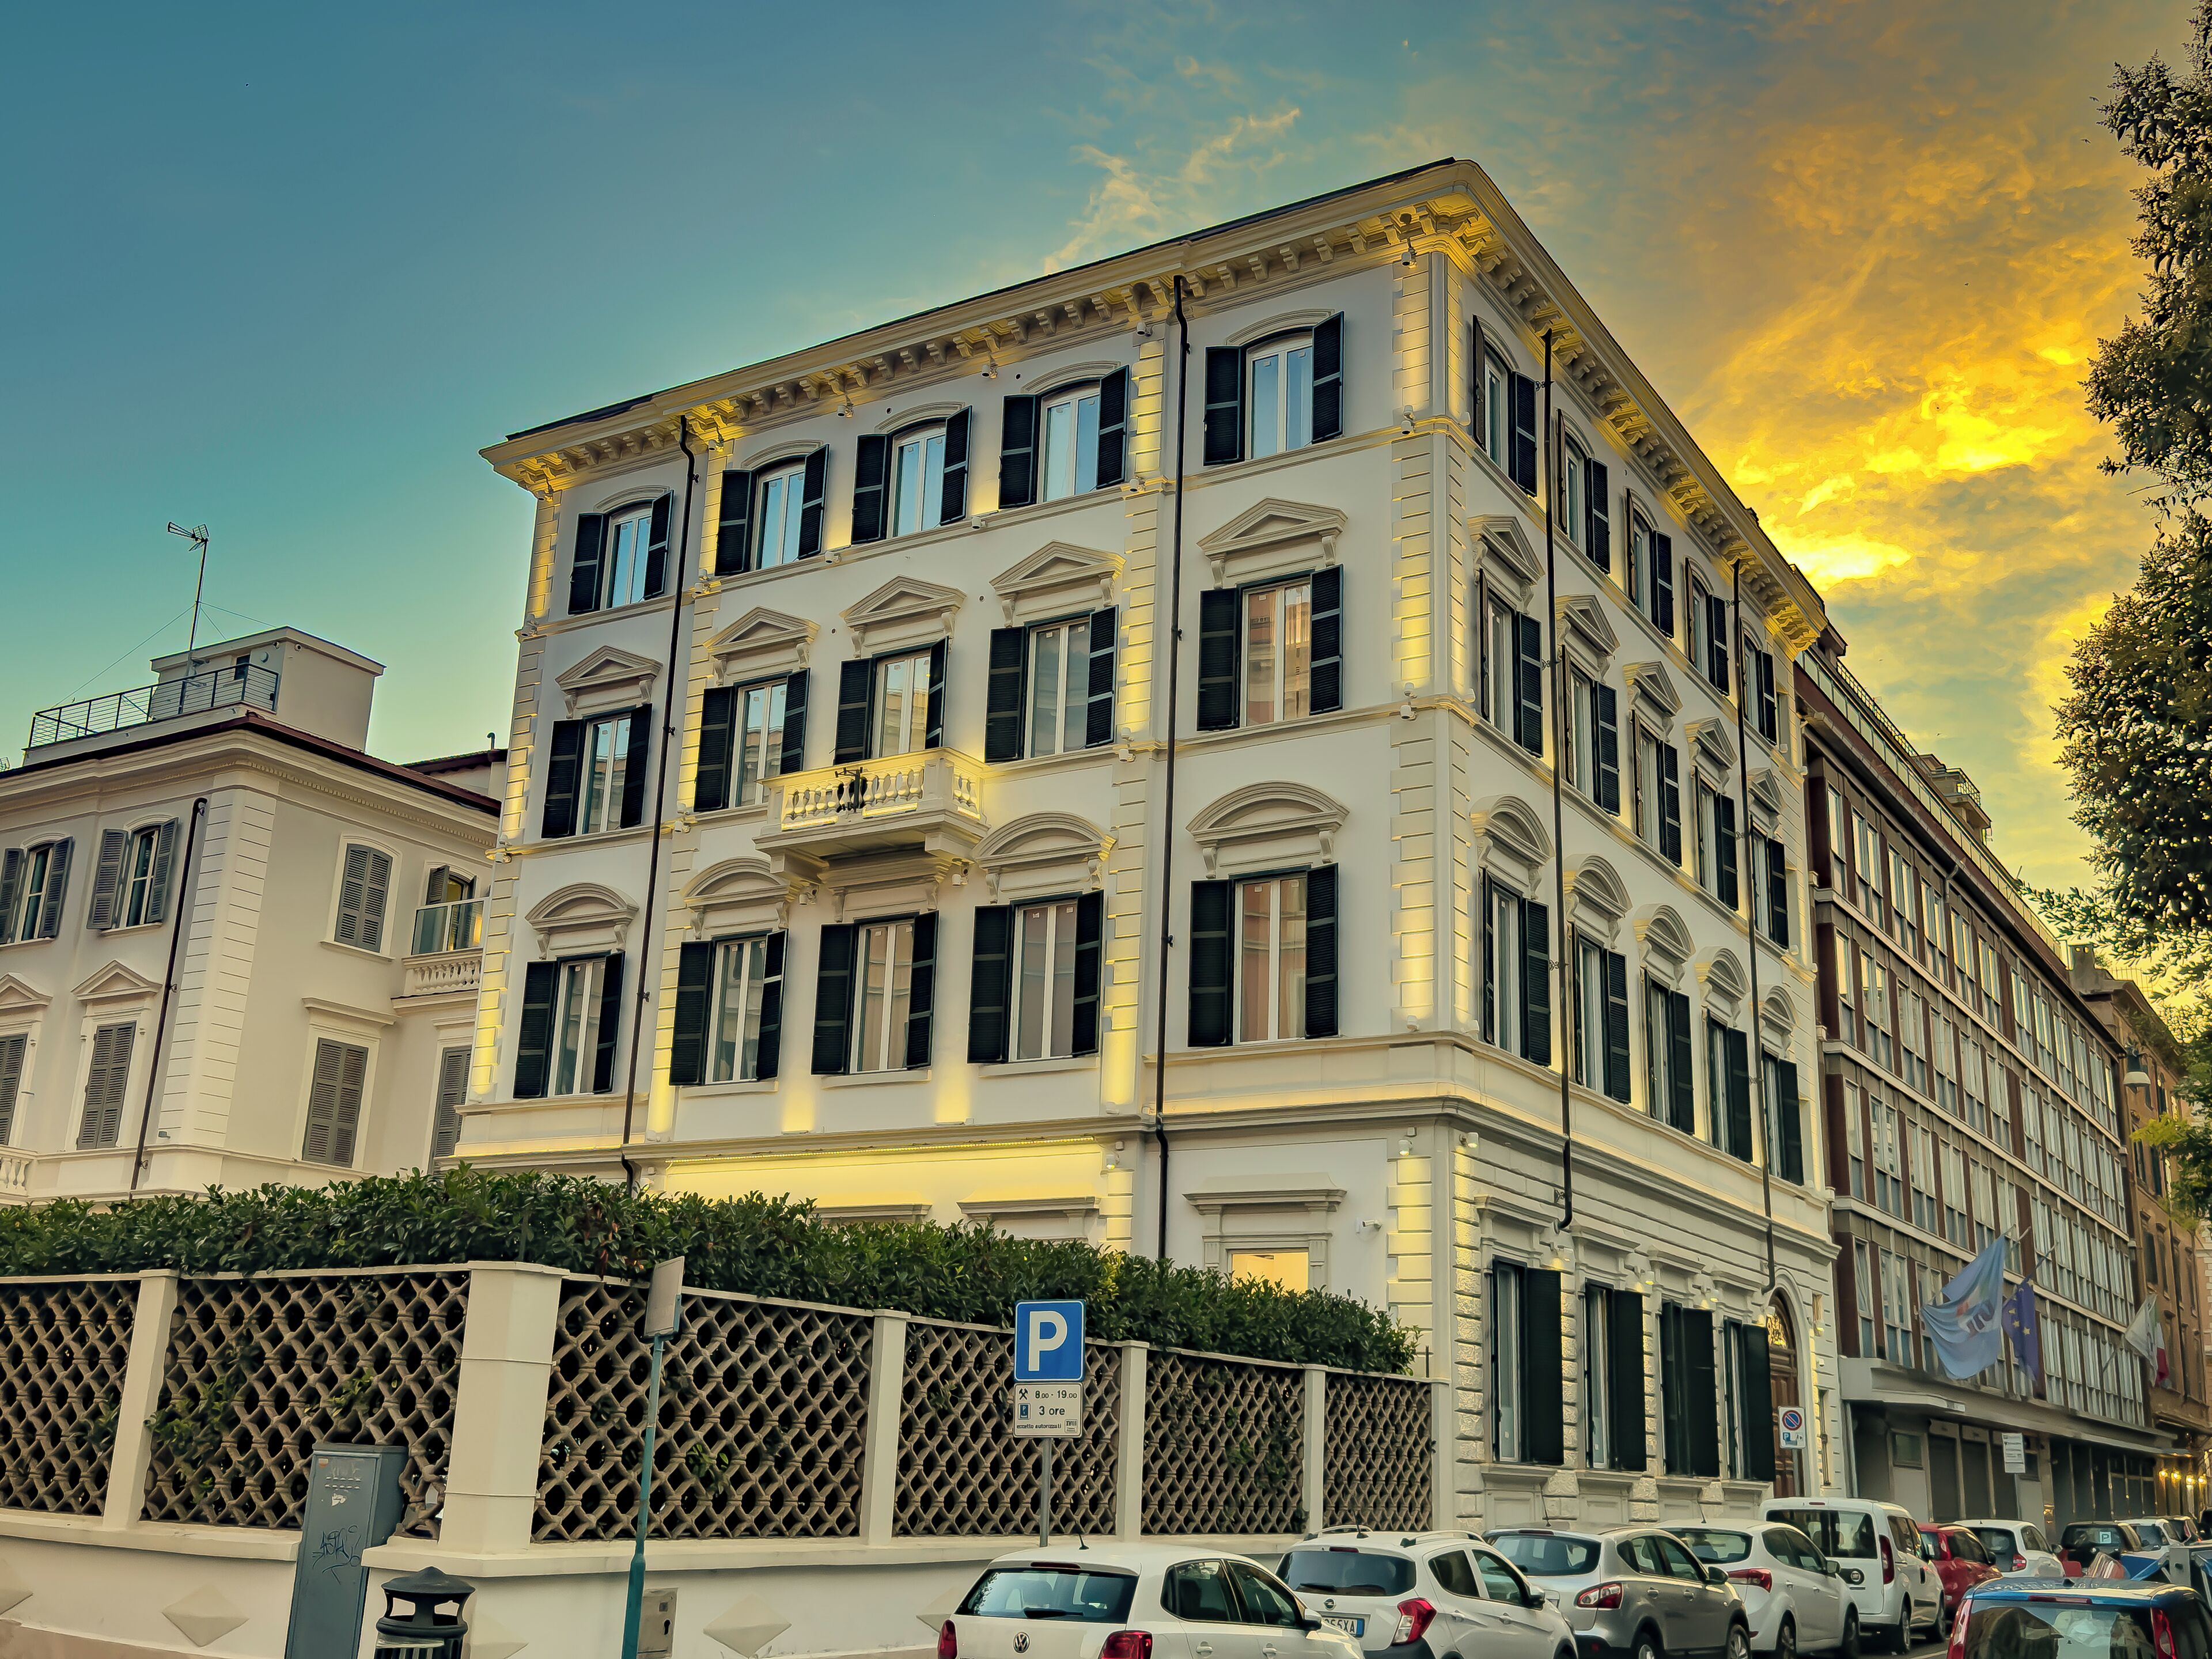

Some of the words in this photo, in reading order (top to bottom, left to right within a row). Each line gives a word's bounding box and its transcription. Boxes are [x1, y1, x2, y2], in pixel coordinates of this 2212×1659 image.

[1028, 1310, 1067, 1372] P
[1035, 1390, 1050, 1399] 8.00
[1057, 1389, 1078, 1399] 19.00
[1039, 1406, 1045, 1416] 3
[1048, 1407, 1065, 1415] ore
[2101, 1533, 2109, 1542] P
